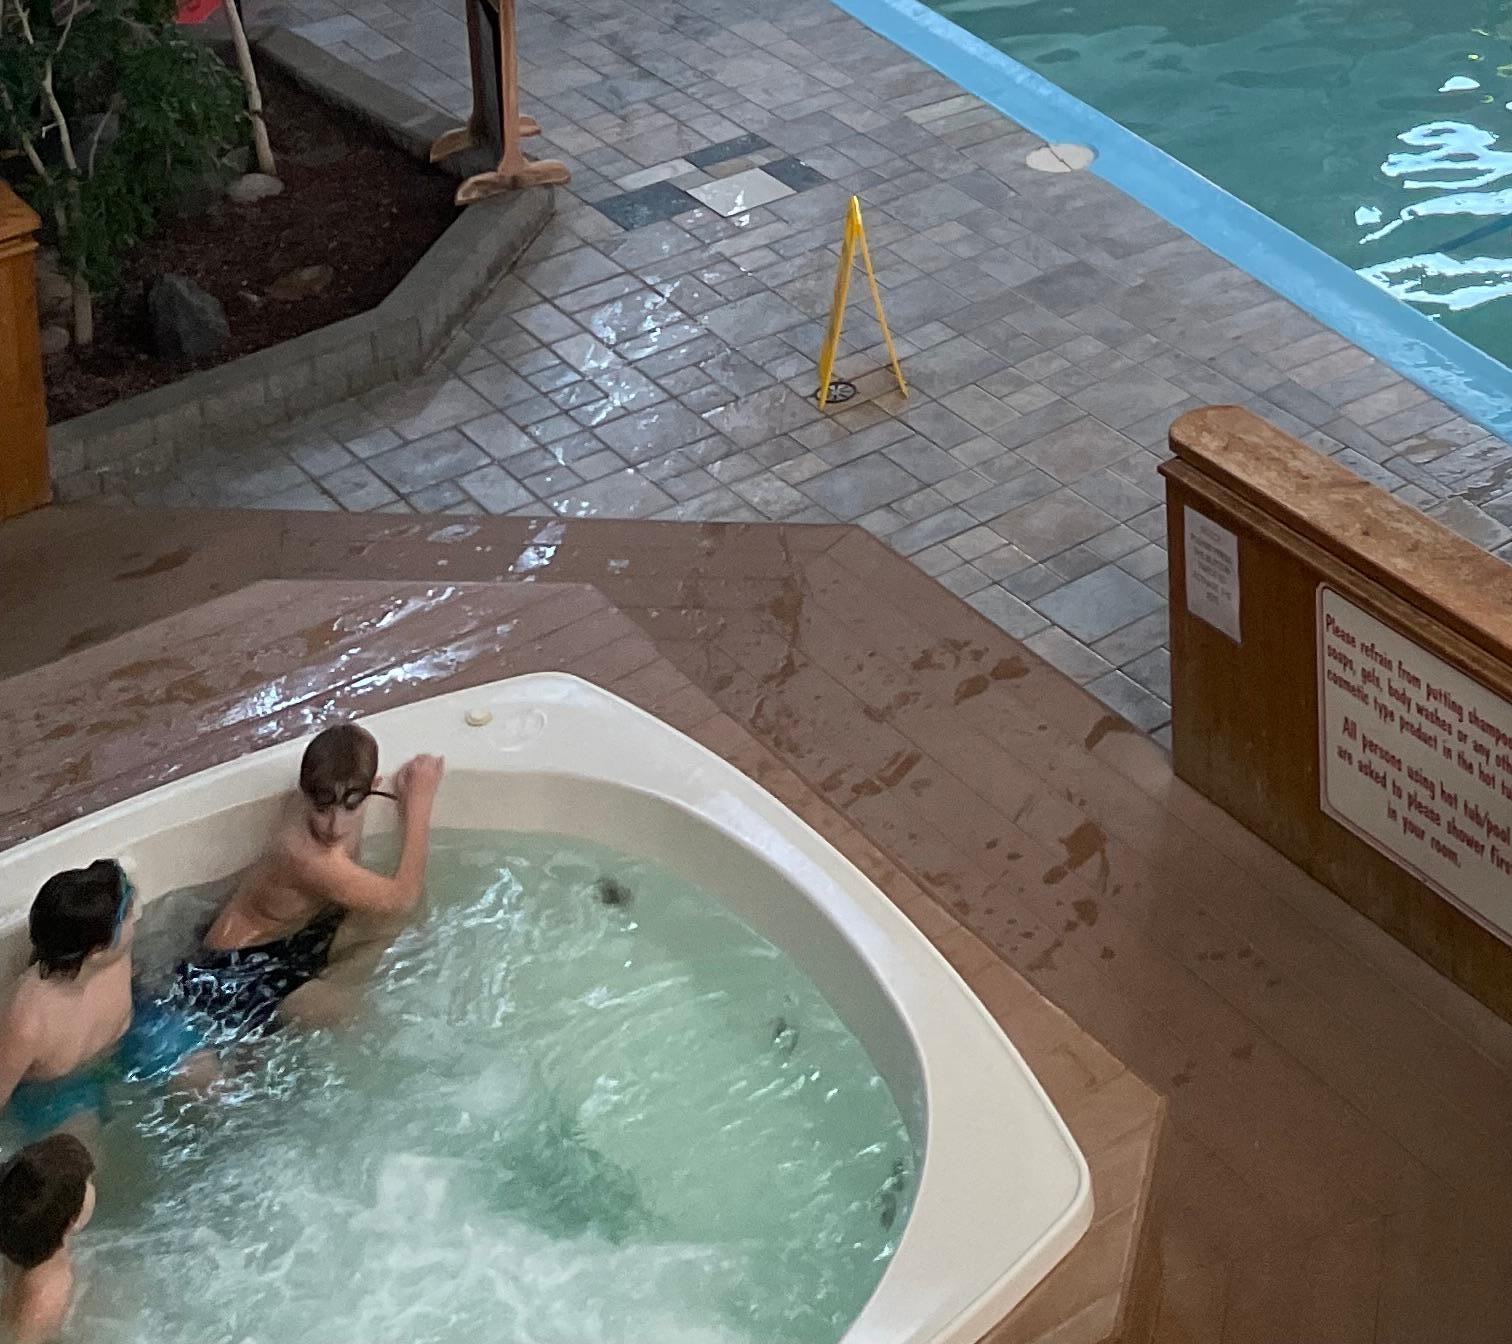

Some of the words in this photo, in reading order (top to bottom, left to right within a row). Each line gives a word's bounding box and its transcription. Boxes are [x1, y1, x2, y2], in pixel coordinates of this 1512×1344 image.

[1326, 613, 1356, 648] Please
[1360, 642, 1393, 672] refrain
[1398, 659, 1421, 690] from
[1427, 682, 1463, 723] putting
[1388, 677, 1412, 714] body
[1416, 702, 1452, 736] washes
[1457, 729, 1468, 745] or
[1472, 739, 1490, 766] any
[1327, 669, 1369, 706] cosmetic
[1373, 695, 1395, 723] type
[1400, 714, 1438, 751] product
[1443, 739, 1452, 760] in
[1458, 750, 1474, 775] the
[1479, 762, 1496, 790] hot
[1342, 716, 1357, 741] All
[1362, 732, 1402, 772] persons
[1407, 765, 1435, 801] using
[1440, 780, 1458, 811] hot
[1464, 799, 1510, 846] tub/pool
[1337, 745, 1353, 766] are
[1358, 759, 1387, 789] asked
[1392, 778, 1402, 800] to
[1407, 791, 1441, 827] please
[1447, 817, 1485, 858] shower
[1388, 801, 1397, 822] in
[1402, 815, 1426, 840] your
